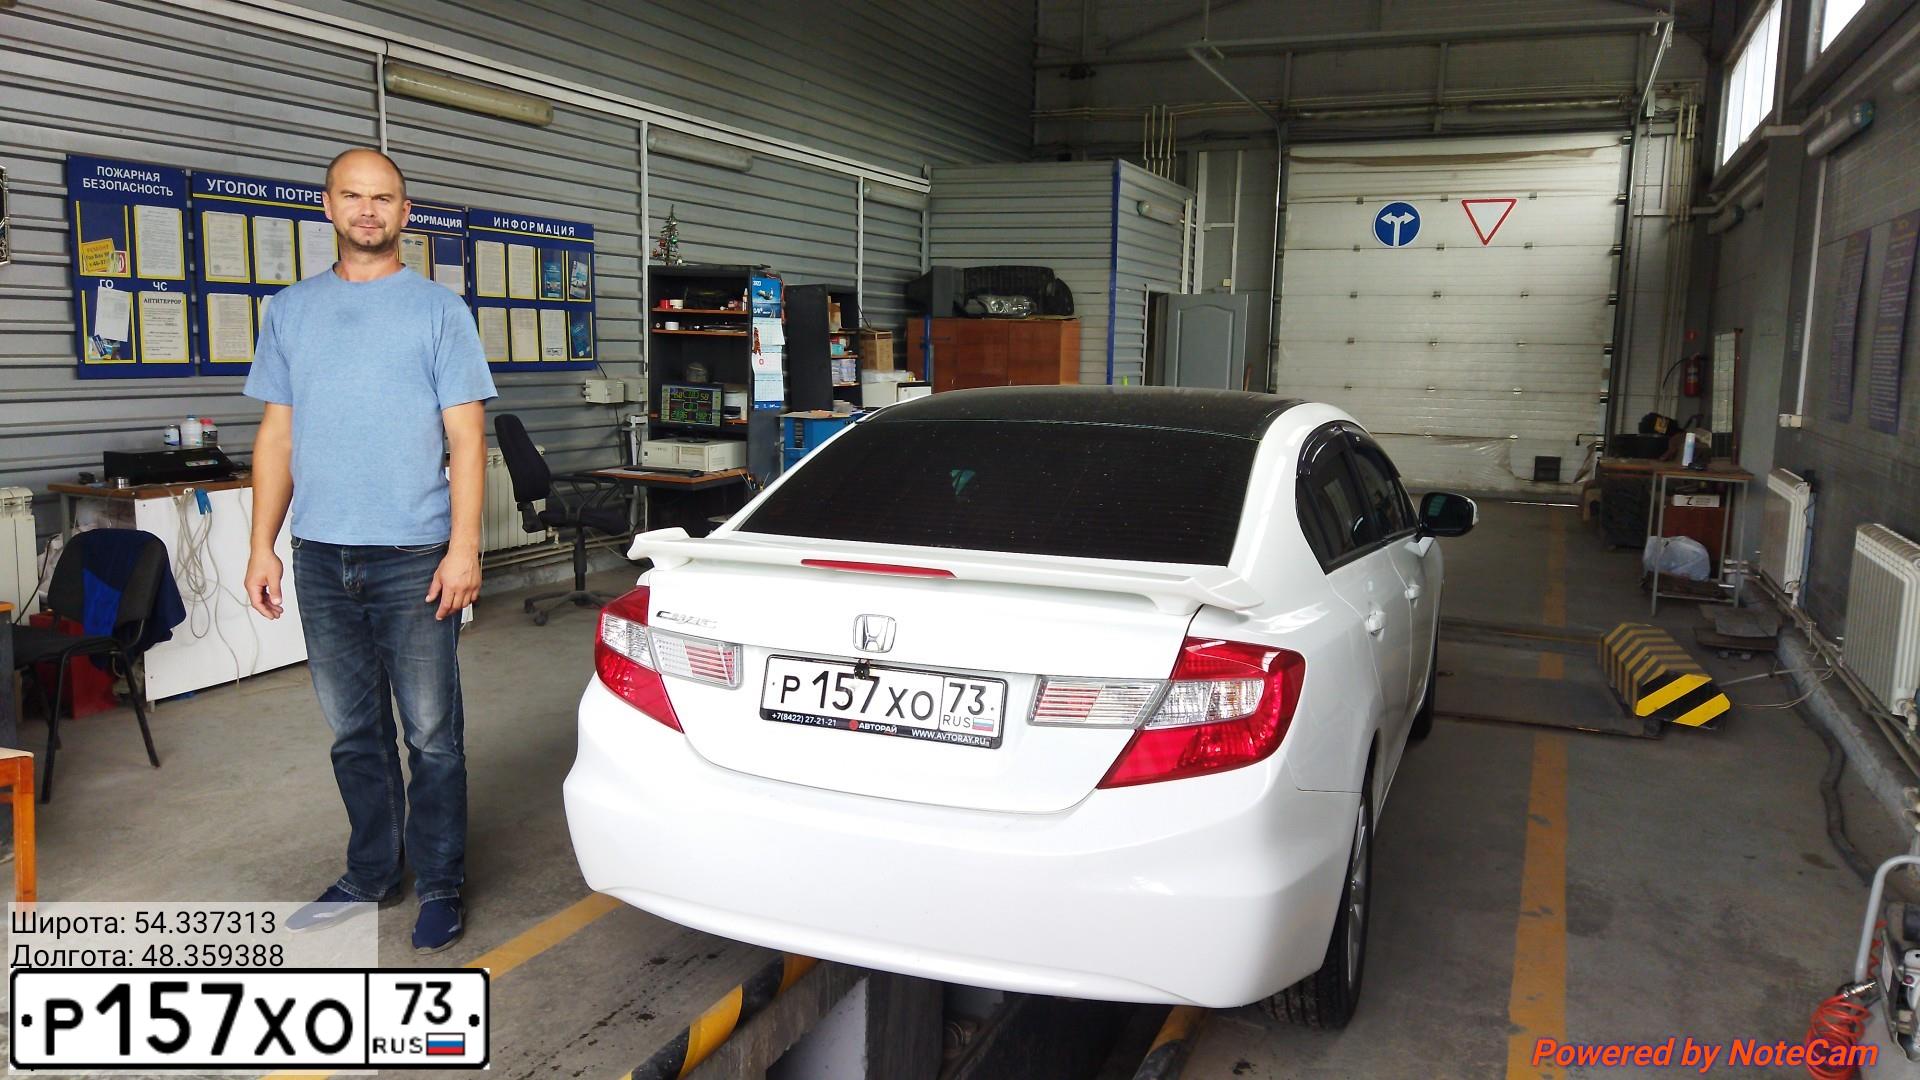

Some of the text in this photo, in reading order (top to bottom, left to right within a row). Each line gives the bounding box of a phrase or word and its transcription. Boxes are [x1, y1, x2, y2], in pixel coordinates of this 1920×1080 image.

[97, 166, 160, 182] ПОЖАРНАЯ
[83, 178, 174, 196] БЕЗОПАСНОСТЬ
[206, 178, 322, 203] УГОЛОК ПОТРЕ
[409, 213, 462, 228] ФОРМАЦИЯ
[493, 216, 575, 236] ИНФОРМАЦИЯ
[153, 282, 168, 291] ЧС
[949, 682, 986, 715] 73
[804, 715, 837, 727] 27-21-21
[858, 722, 898, 734] АВТОРАЙ
[942, 714, 971, 728] RUS
